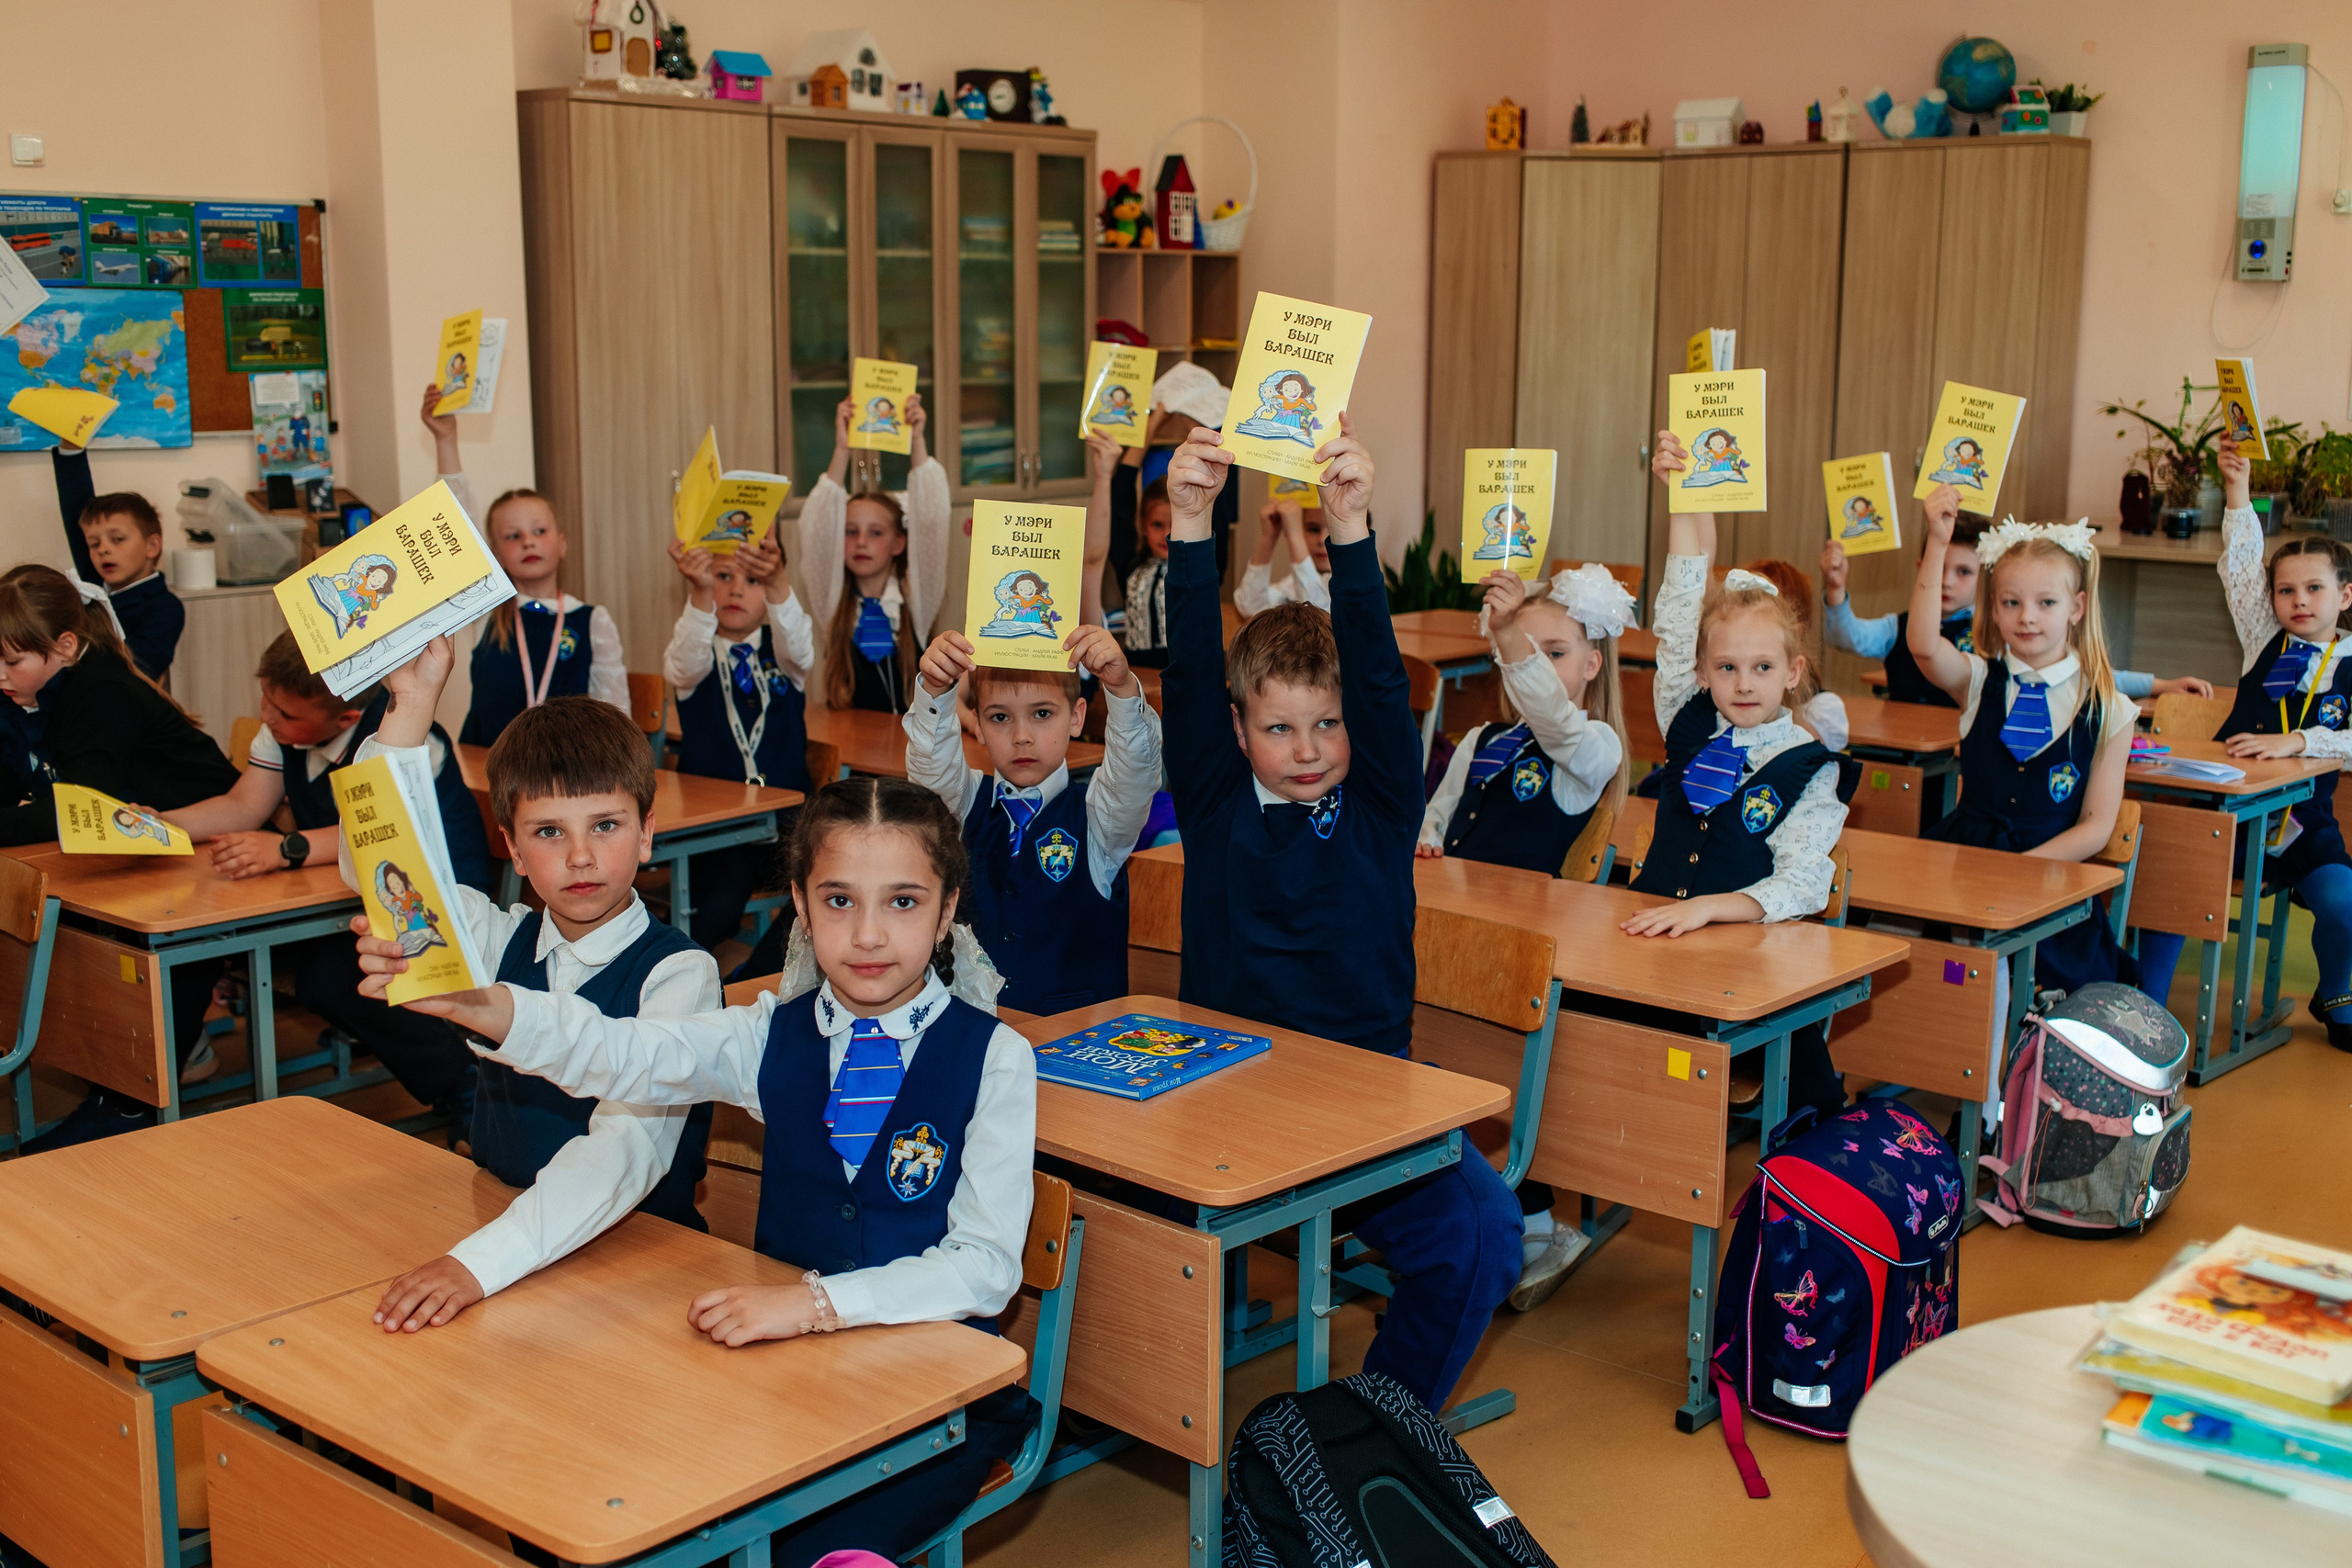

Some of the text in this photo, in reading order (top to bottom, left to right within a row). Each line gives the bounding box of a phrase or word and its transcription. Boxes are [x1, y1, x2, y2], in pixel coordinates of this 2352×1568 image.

[1283, 310, 1332, 331] У МЭРИ
[1287, 328, 1319, 344] БЫЛ
[1264, 340, 1335, 365] БАРАШЕК
[1694, 382, 1735, 393] У МЭРИ
[1702, 396, 1727, 405] БЫЛ
[1961, 396, 1995, 411] У МЭРИ
[1686, 407, 1744, 419] БАРАШЕК
[1963, 408, 1985, 420] БЫЛ
[1948, 415, 1996, 434] БАРАШЕК
[1487, 460, 1527, 468] У МЭРИ
[1494, 472, 1520, 481] БЫЛ
[1478, 484, 1534, 494] БАРАШЕК
[1004, 515, 1053, 528] У МЭРИ
[432, 513, 463, 557] У МЭРИ
[1012, 531, 1043, 543] БЫЛ
[419, 529, 442, 558] БЫЛ
[395, 524, 435, 585] БАРАШЕК
[991, 545, 1061, 560] БАРАШЕК
[345, 782, 375, 804] У МЭРИ
[355, 806, 378, 824] БЫЛ
[353, 822, 399, 849] БАРАШЕК
